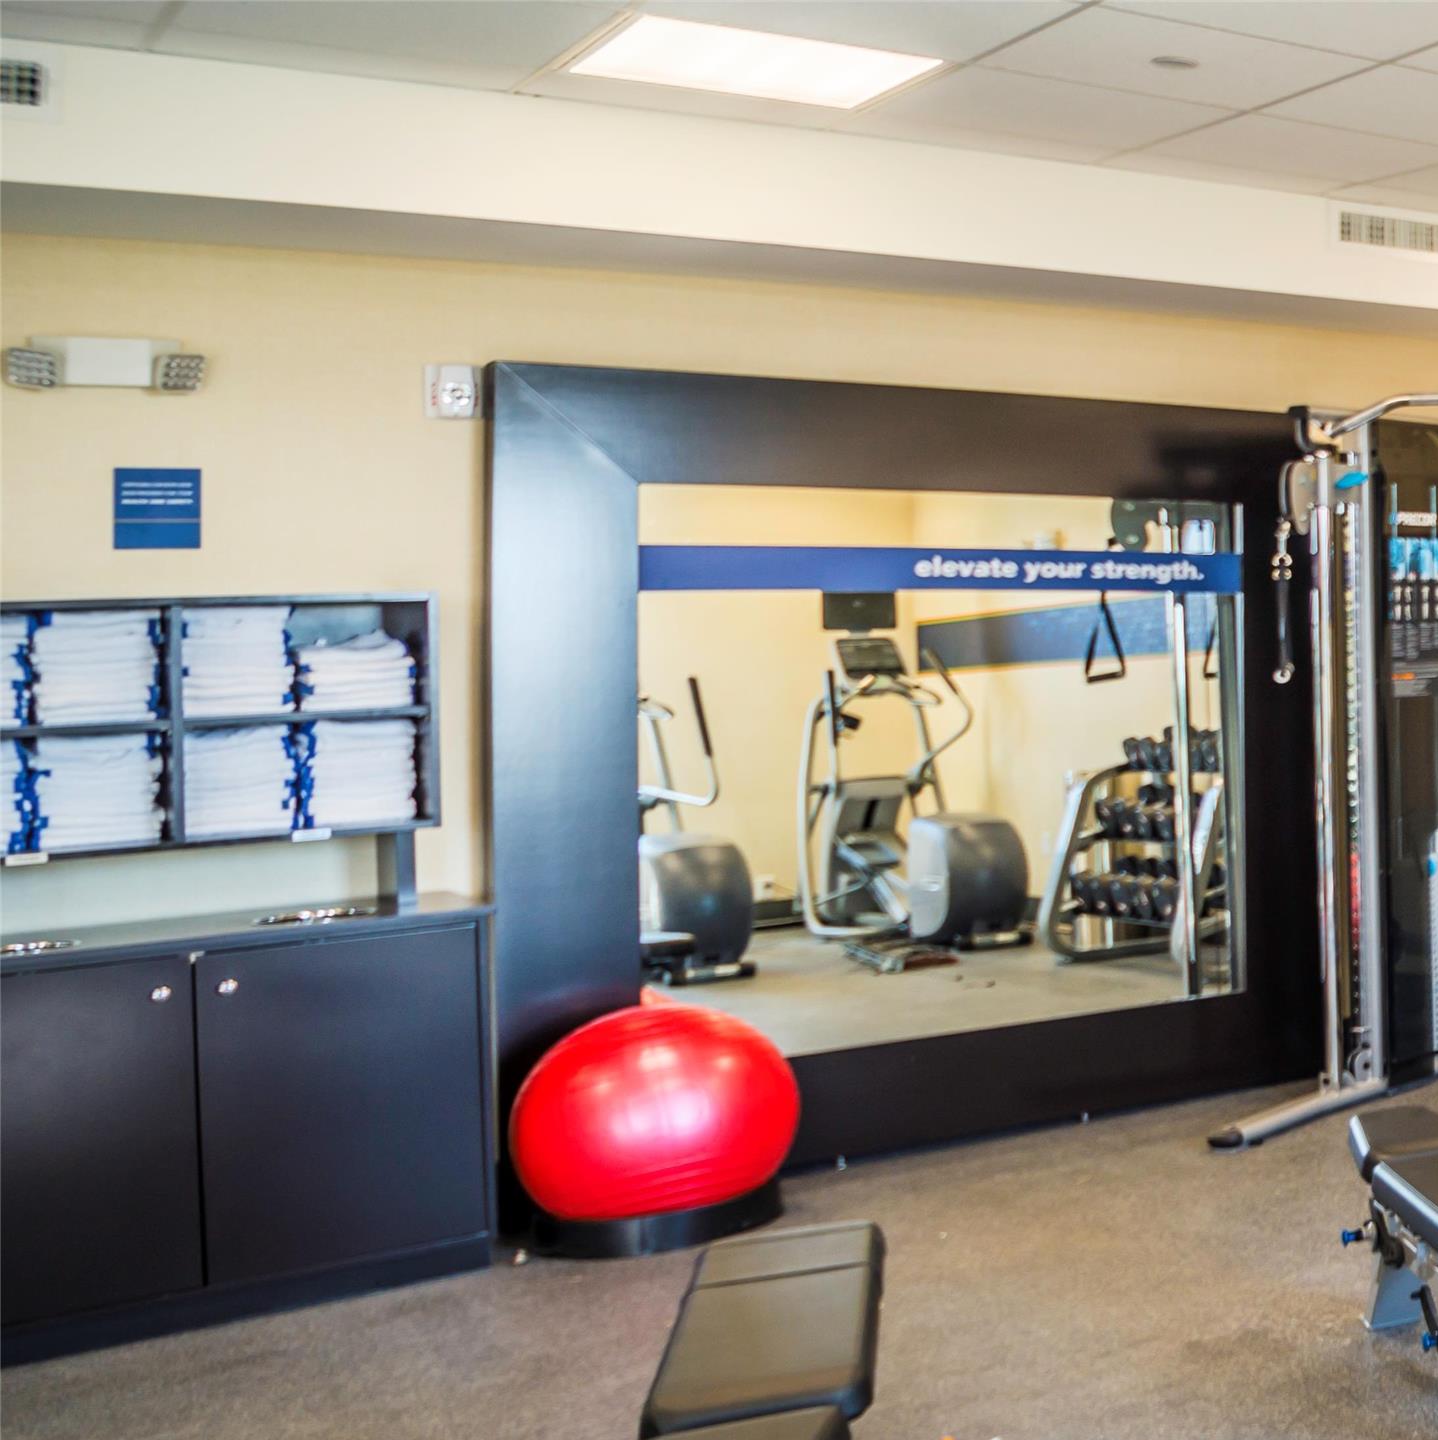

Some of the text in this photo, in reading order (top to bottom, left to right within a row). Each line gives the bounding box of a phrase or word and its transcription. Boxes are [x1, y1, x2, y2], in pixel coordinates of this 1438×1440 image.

[913, 555, 1205, 585] elevate your strength.
